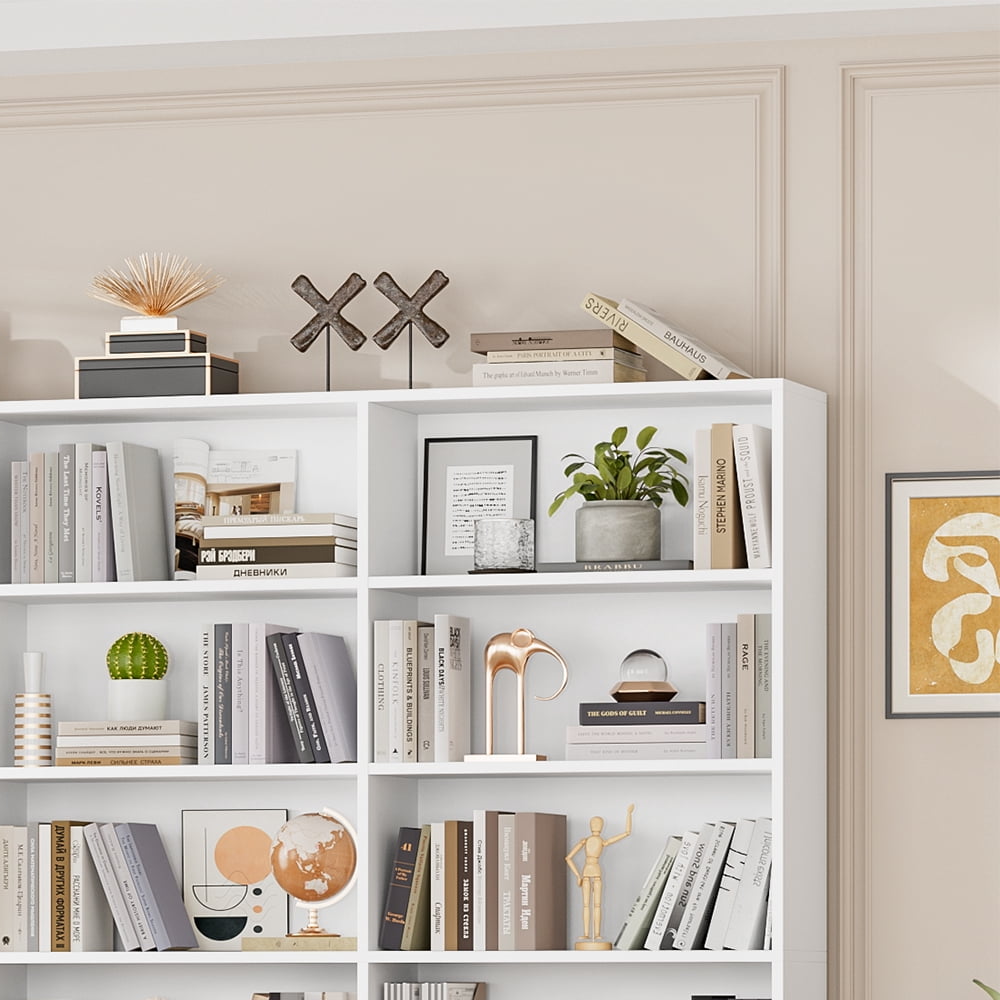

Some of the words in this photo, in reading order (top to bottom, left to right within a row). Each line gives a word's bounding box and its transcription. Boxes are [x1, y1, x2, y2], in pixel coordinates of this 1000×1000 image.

[584, 297, 629, 332] RIVERS
[663, 330, 707, 364] BAUHAUS
[715, 458, 726, 492] MARINO
[62, 508, 70, 526] They
[696, 502, 709, 536] Noguchi
[715, 495, 726, 534] STEPHEN
[201, 548, 216, 562] РЭЙ
[218, 549, 256, 563] БРЭДБЕРИ
[233, 568, 287, 577] ДНЕВНИКИ
[235, 678, 243, 712] Anything?
[377, 664, 385, 711] CLOTHING
[54, 825, 67, 854] ДУМАЙ
[54, 865, 65, 895] ДРУГИХ
[56, 898, 65, 941] ФОРМАТАХ
[433, 902, 442, 934] Спартак
